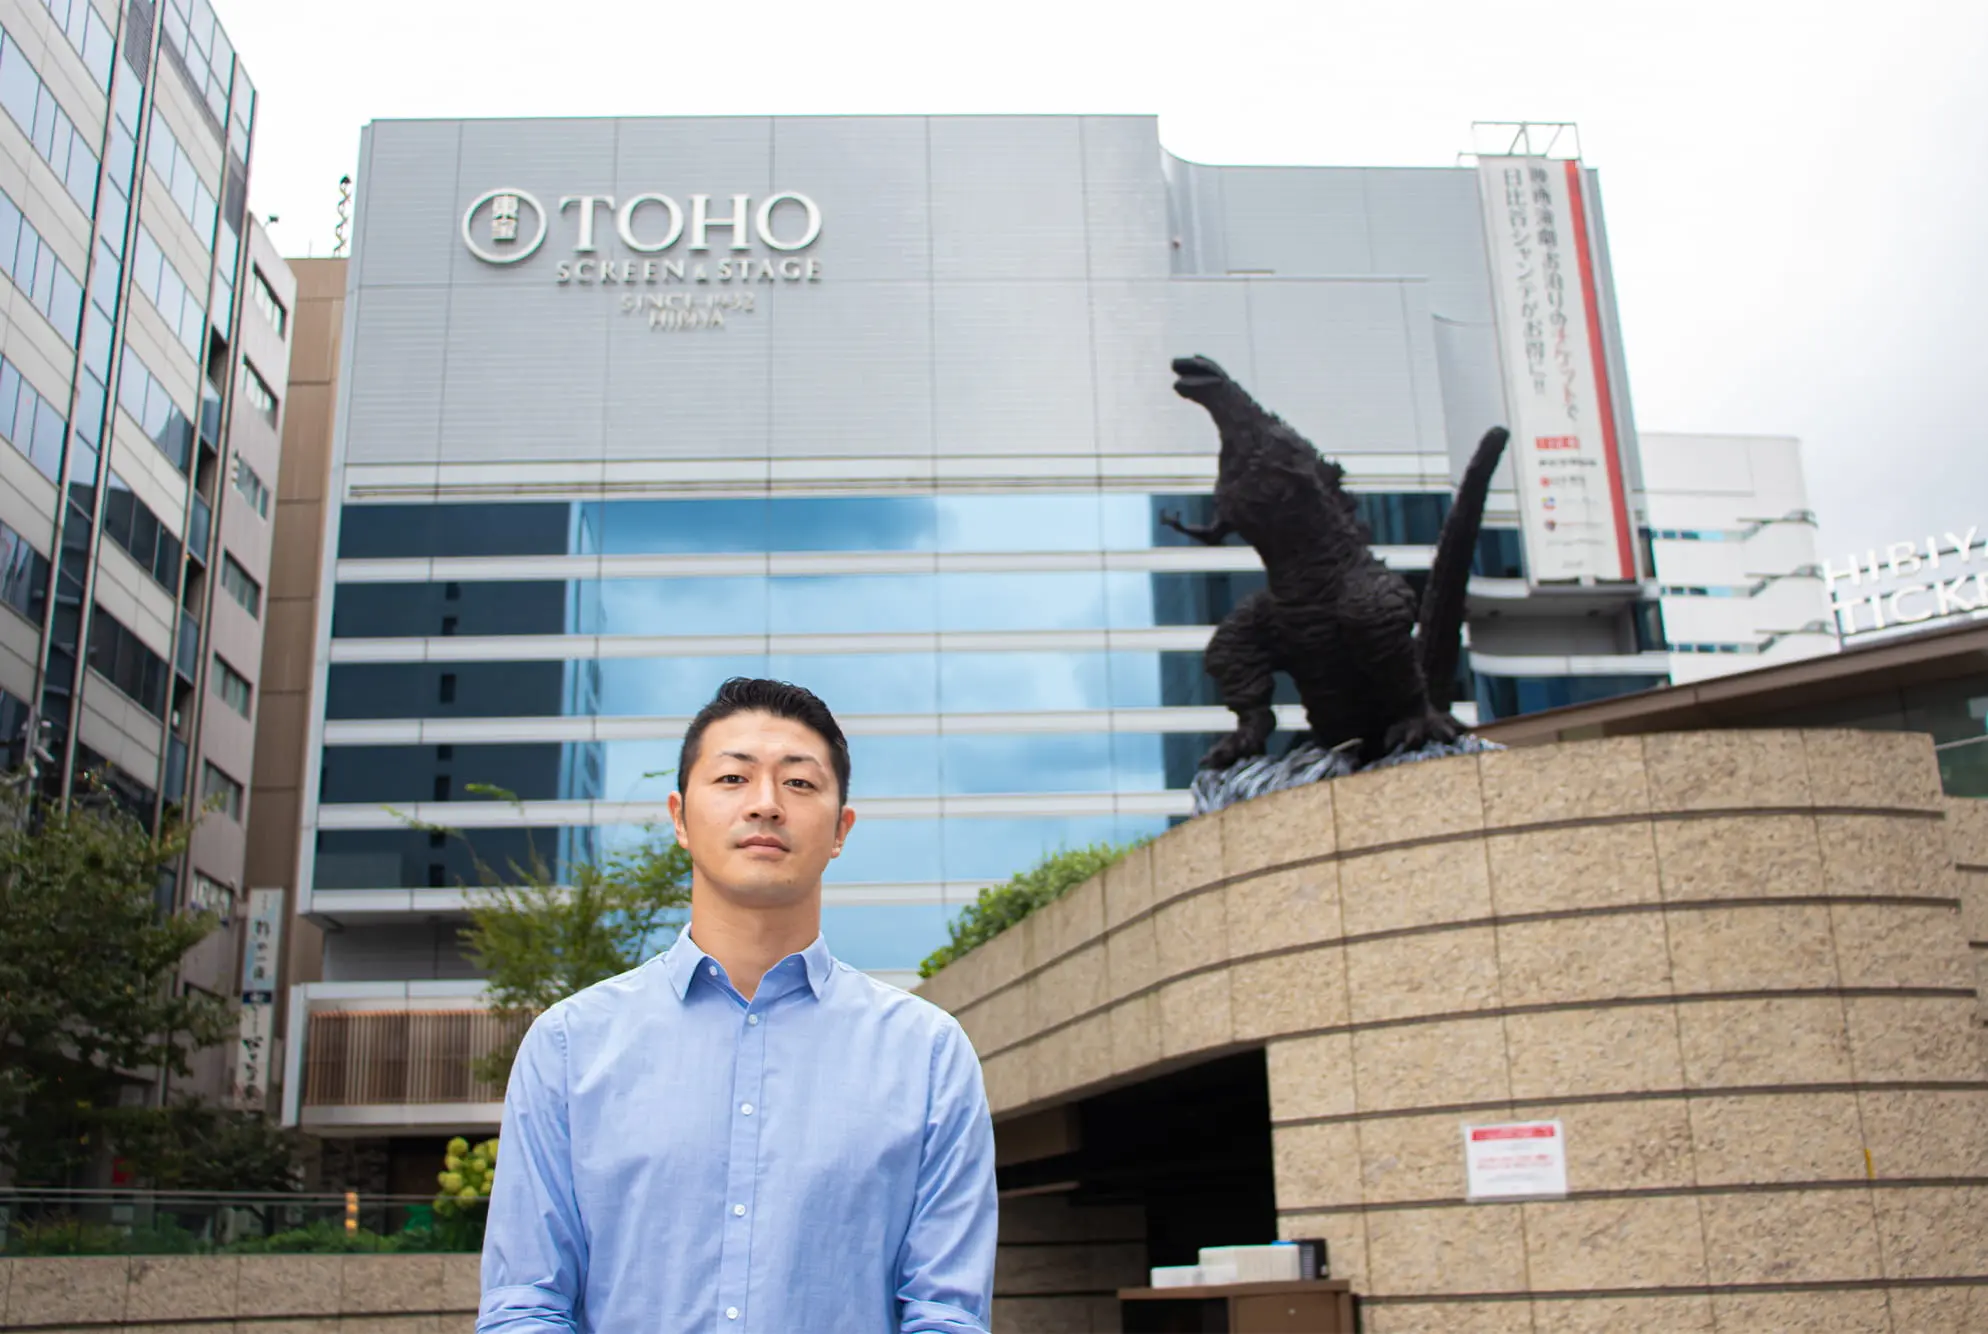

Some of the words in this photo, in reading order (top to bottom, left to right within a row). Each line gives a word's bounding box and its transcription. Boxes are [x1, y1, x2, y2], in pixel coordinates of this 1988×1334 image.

[559, 191, 823, 253] TOHO
[556, 257, 686, 285] SCREEN
[716, 256, 824, 283] STAGE
[1822, 526, 1988, 592] HIBIY
